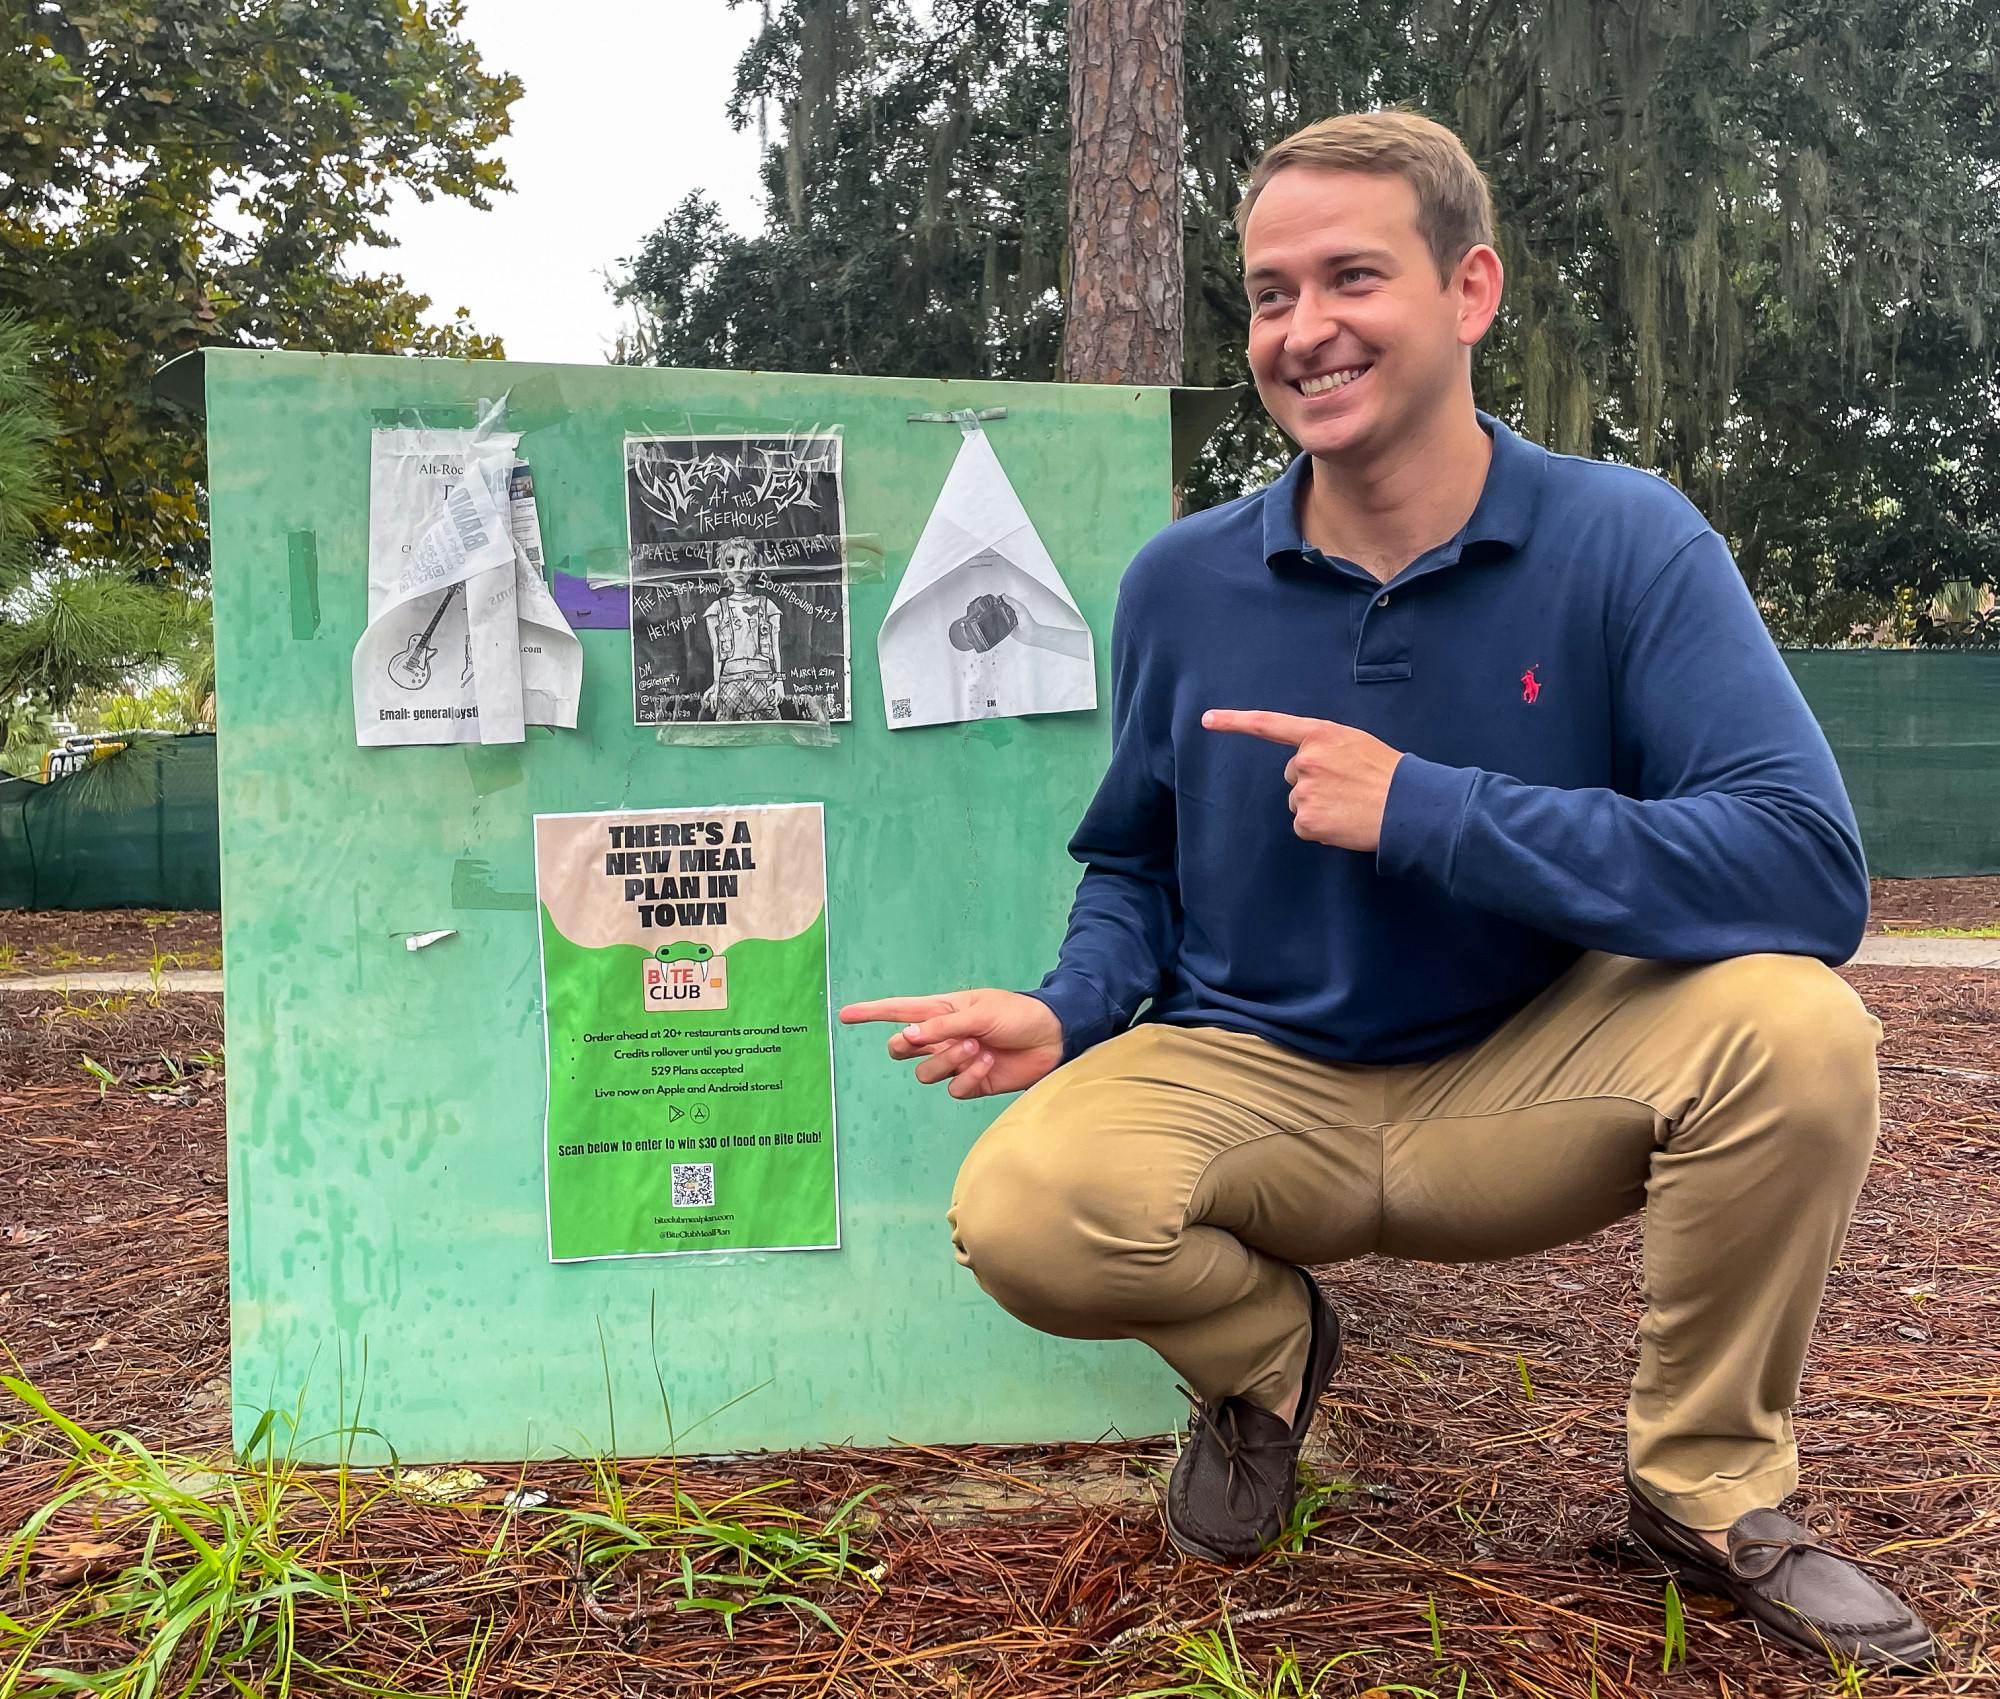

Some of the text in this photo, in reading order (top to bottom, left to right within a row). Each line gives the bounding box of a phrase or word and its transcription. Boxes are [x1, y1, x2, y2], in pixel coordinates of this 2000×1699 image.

[419, 464, 463, 475] Alt-Roc
[732, 491, 756, 507] THE
[637, 543, 679, 562] PEACE
[800, 534, 835, 559] PARTY
[634, 593, 656, 616] THE
[698, 577, 721, 595] BAND
[755, 572, 813, 614] SOUTHBOUND
[639, 662, 652, 678] DM
[790, 667, 817, 679] MARCH
[379, 705, 479, 720] Email: generaljoysti
[50, 755, 86, 782] CAT
[608, 821, 752, 849] THERE'S A
[606, 847, 756, 875] NEW MEAL
[625, 875, 738, 901] PLAN IN
[638, 902, 727, 928] TOWN
[650, 985, 701, 1000] CLUB
[583, 1024, 808, 1043] Order ahead at 20+ restaurants around town
[614, 1044, 782, 1059] Credits rollover until you graduate
[651, 1064, 744, 1076] 529 Plans accepted
[595, 1080, 783, 1097] Live now on Apple and Android stores!
[558, 1131, 822, 1156] Scan below to enter to win $30 of food on Bite Club!
